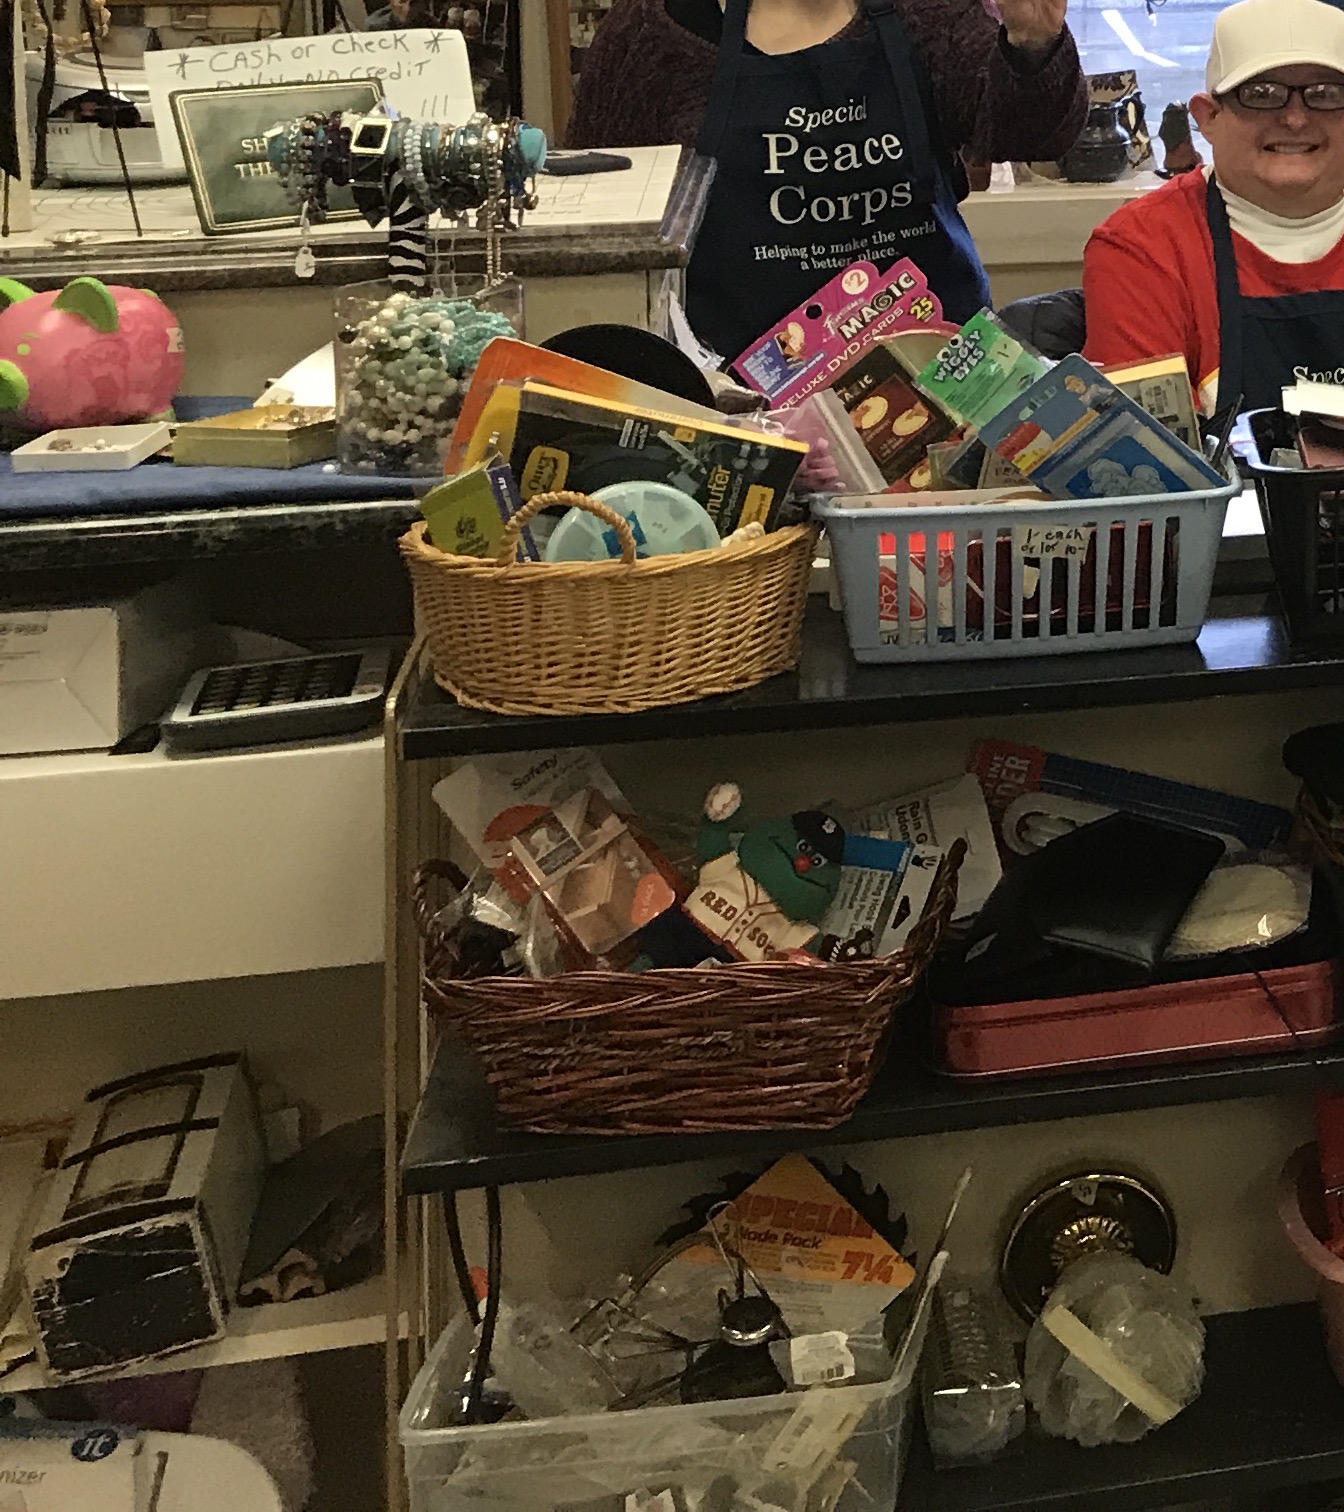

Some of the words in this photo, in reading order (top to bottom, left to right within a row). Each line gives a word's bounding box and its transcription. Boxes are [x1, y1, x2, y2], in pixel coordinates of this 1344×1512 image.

[291, 45, 316, 60] or
[784, 95, 867, 133] Special
[762, 133, 903, 174] Peace
[769, 181, 913, 225] Corps
[754, 245, 808, 261] Helping
[811, 243, 826, 255] to
[830, 238, 868, 254] make
[872, 231, 896, 245] the
[900, 220, 937, 239] world
[800, 261, 809, 271] a
[811, 256, 852, 270] better
[838, 270, 917, 341] MAGIC
[909, 297, 934, 321] 25
[780, 371, 828, 411] DELUXE
[826, 340, 861, 373] DVD
[861, 307, 904, 346] CARDS
[933, 329, 982, 382] WIGGLY
[952, 346, 986, 382] EYES
[699, 890, 738, 922] RED
[782, 1231, 823, 1250] Pack
